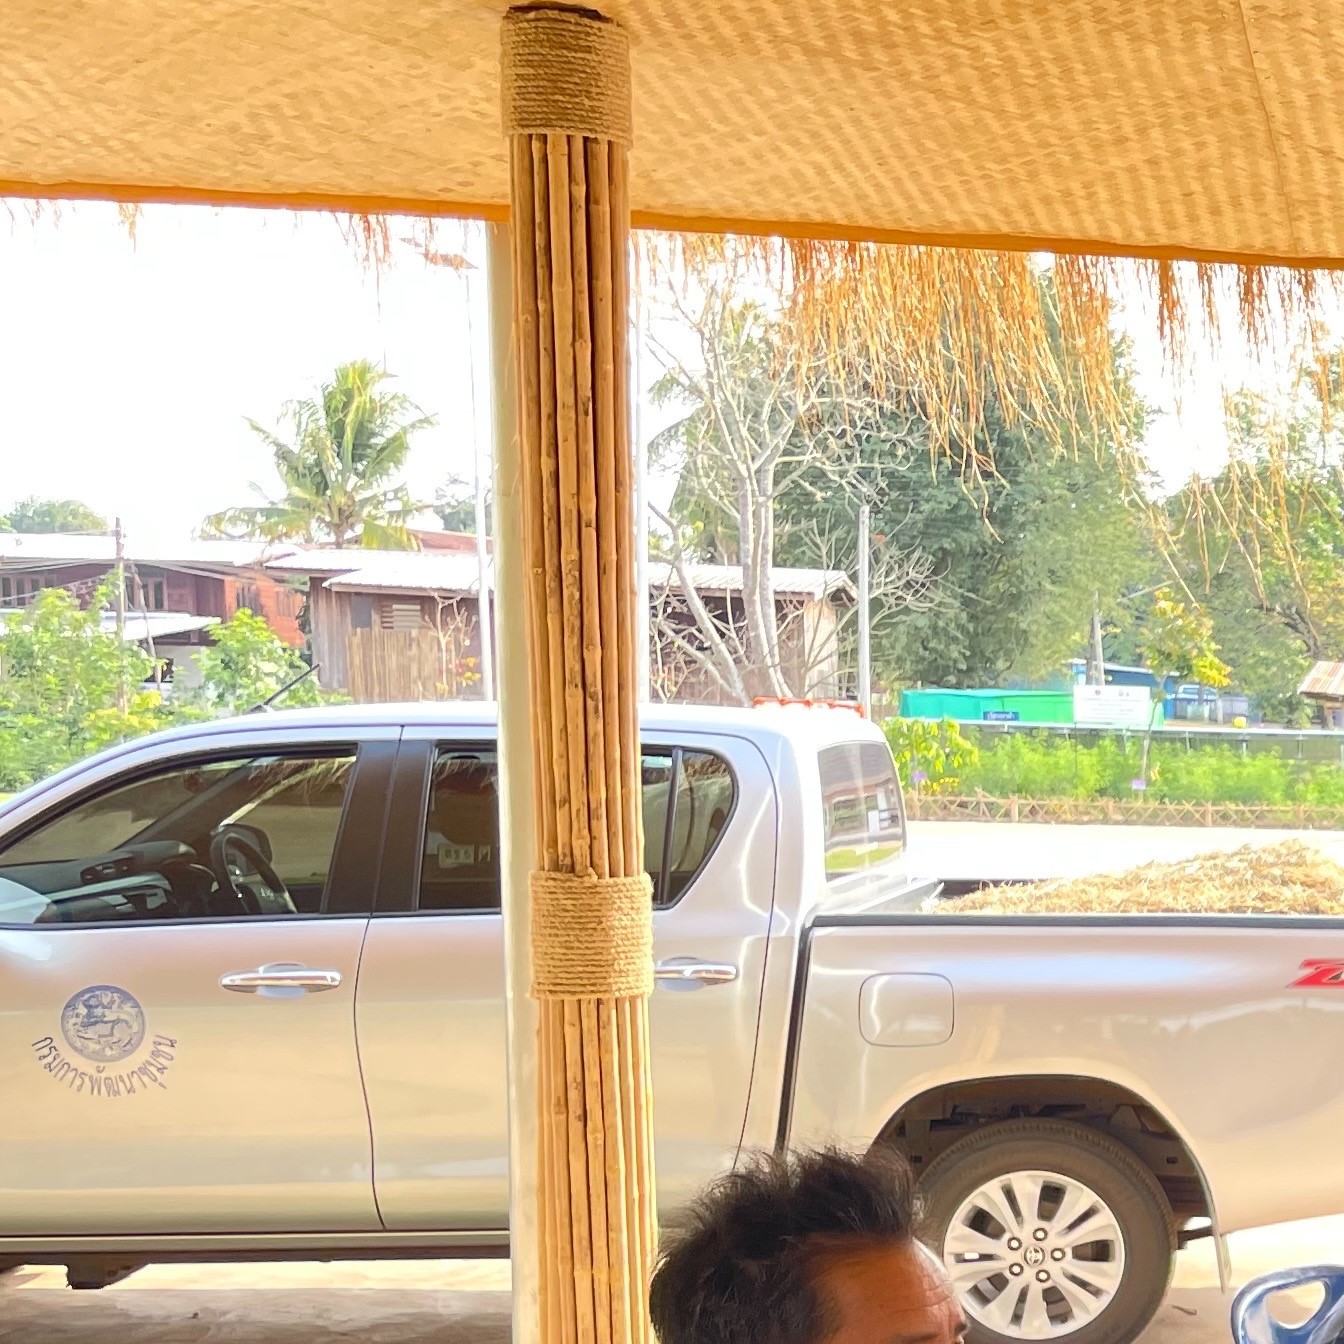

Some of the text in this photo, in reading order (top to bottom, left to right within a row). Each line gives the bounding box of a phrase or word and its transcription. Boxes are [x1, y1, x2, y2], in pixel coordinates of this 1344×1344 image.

[31, 1034, 178, 1097] กรมการพัฒนาชุมชน
